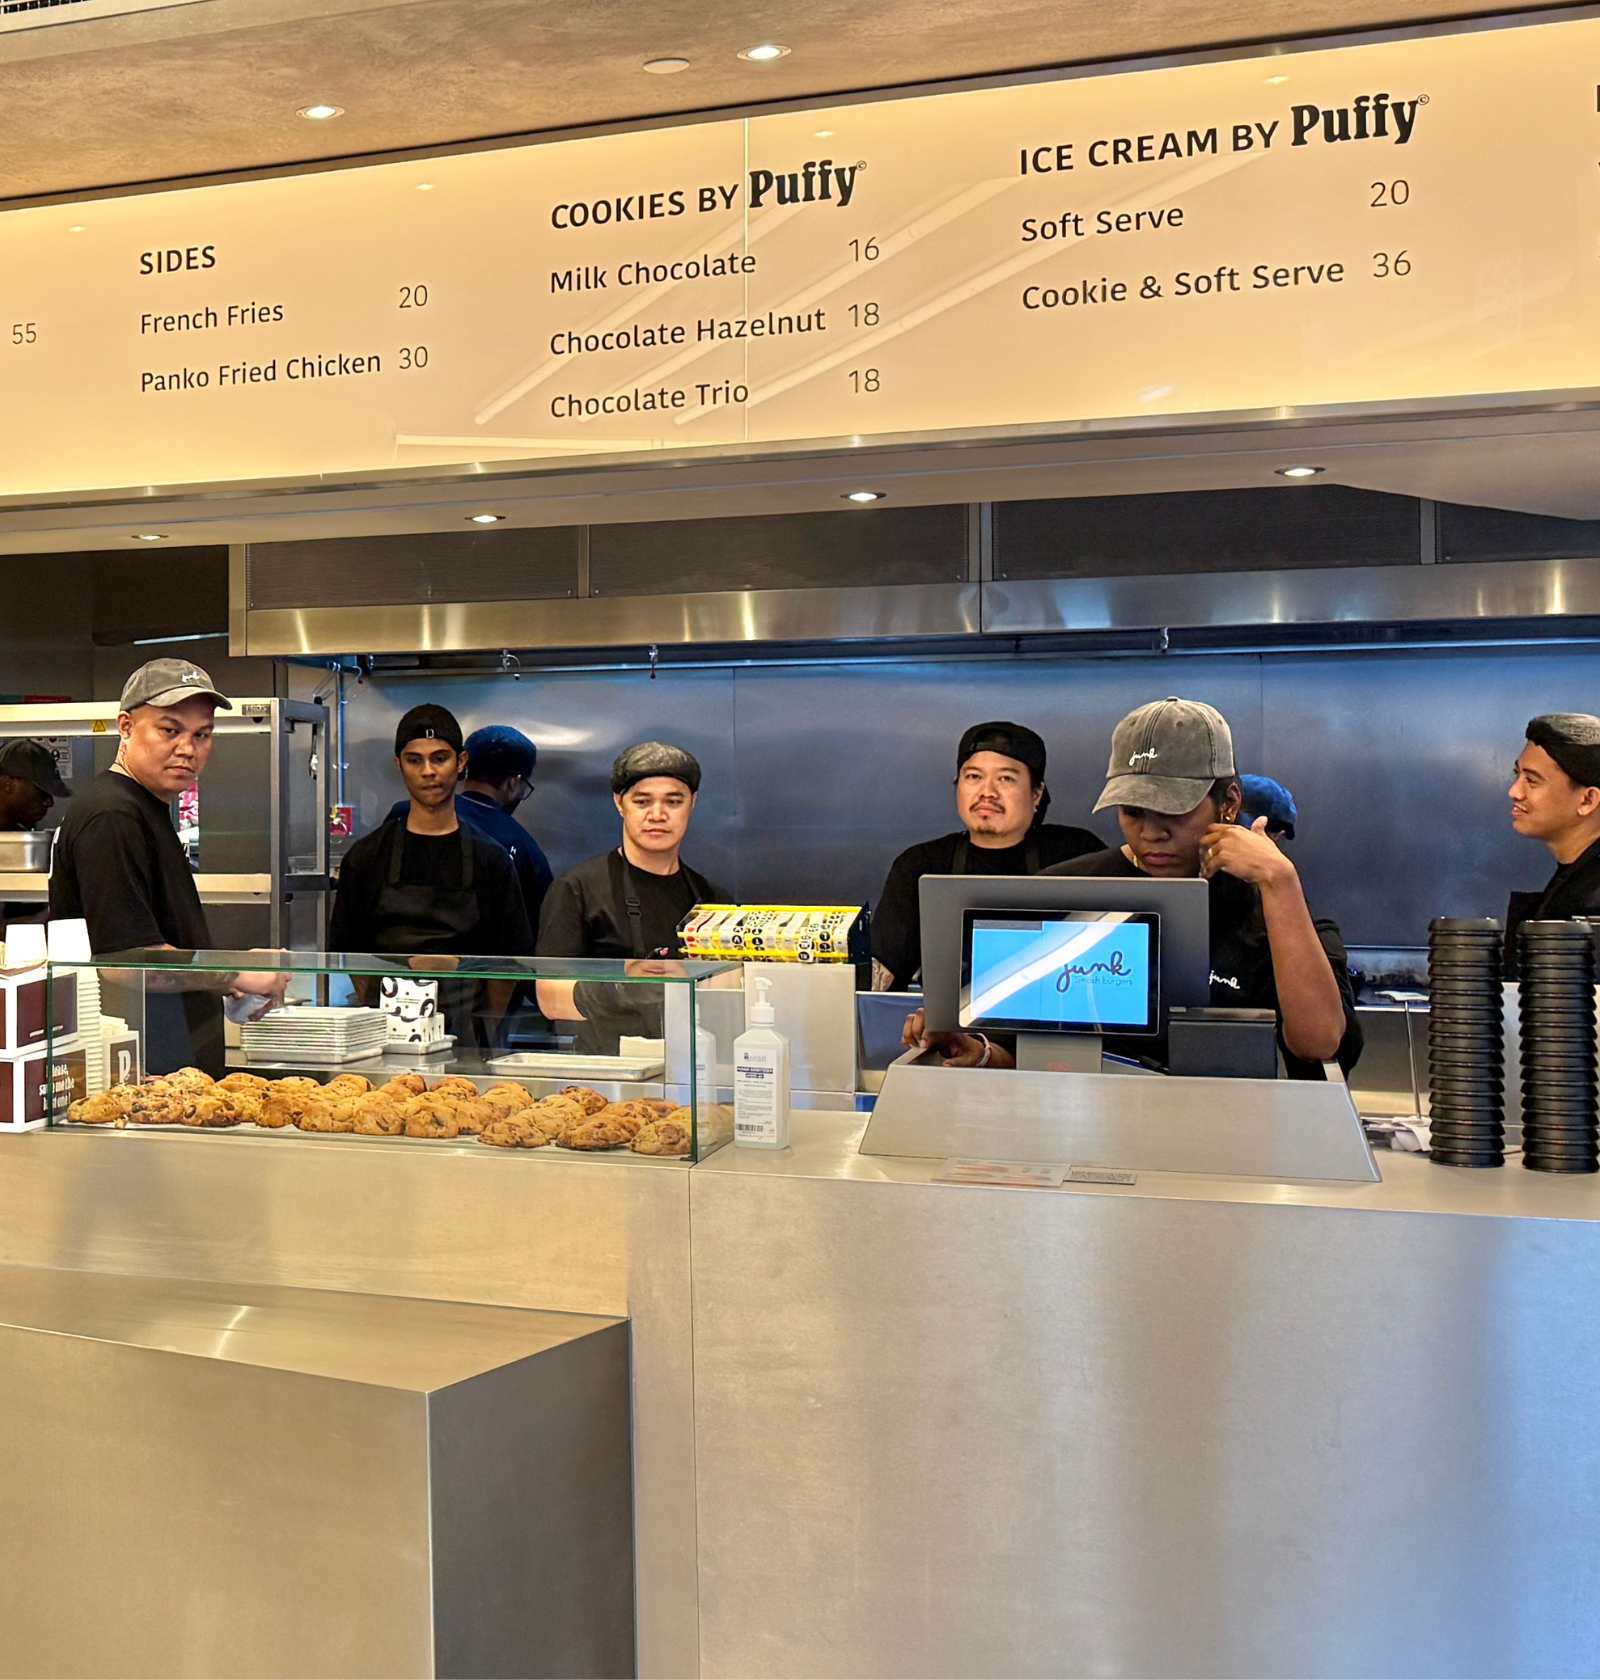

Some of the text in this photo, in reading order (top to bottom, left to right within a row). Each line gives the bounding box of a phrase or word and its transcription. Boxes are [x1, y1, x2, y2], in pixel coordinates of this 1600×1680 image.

[1021, 144, 1073, 175] ICE
[1089, 128, 1217, 166] CREAM
[1233, 121, 1279, 151] BY
[552, 191, 684, 229] COOKIES
[699, 184, 739, 212] BY
[1022, 180, 1409, 241] Soft Serve 20
[140, 246, 215, 275] SIDES
[552, 237, 879, 293] Milk Chocolate 16
[1023, 250, 1411, 309] Cookie & Soft Serve 36
[13, 323, 36, 344] 55
[142, 285, 427, 334] French Fries 20
[551, 303, 879, 354] Chocolate Hazelnut 18
[142, 346, 427, 392] Panko Fried Chicken 30
[551, 369, 880, 417] Chocolate Trio 18
[1129, 748, 1158, 766] junk
[1056, 951, 1131, 993] junk
